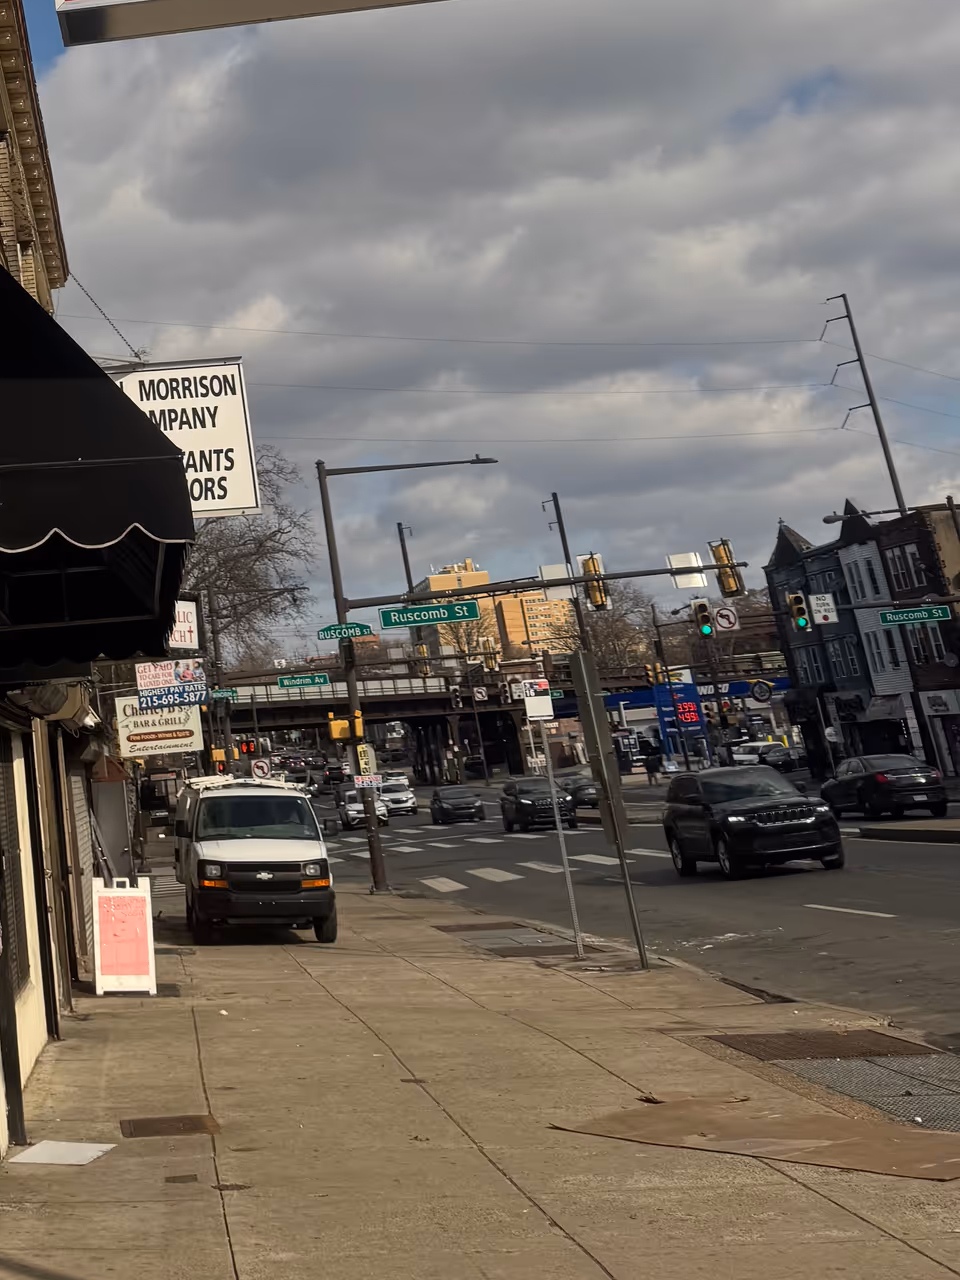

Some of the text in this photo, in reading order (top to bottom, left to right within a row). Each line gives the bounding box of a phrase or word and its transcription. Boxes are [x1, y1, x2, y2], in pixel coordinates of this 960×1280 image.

[138, 374, 237, 402] MORRISON
[148, 405, 219, 431] MPANY
[183, 448, 235, 473] ANTS
[189, 476, 228, 501] ORS
[177, 611, 193, 624] LIC
[390, 606, 469, 623] Ruscomb St
[886, 609, 943, 621] Ruscomb St
[319, 627, 361, 639] RUSCOMB
[137, 662, 172, 674] GET PAID
[140, 684, 206, 696] HIGHEST PAY RATES
[140, 691, 207, 707] 215-695-5877
[133, 720, 150, 729] BAR
[158, 717, 183, 726] GRILL
[128, 741, 194, 753] Entertainment
